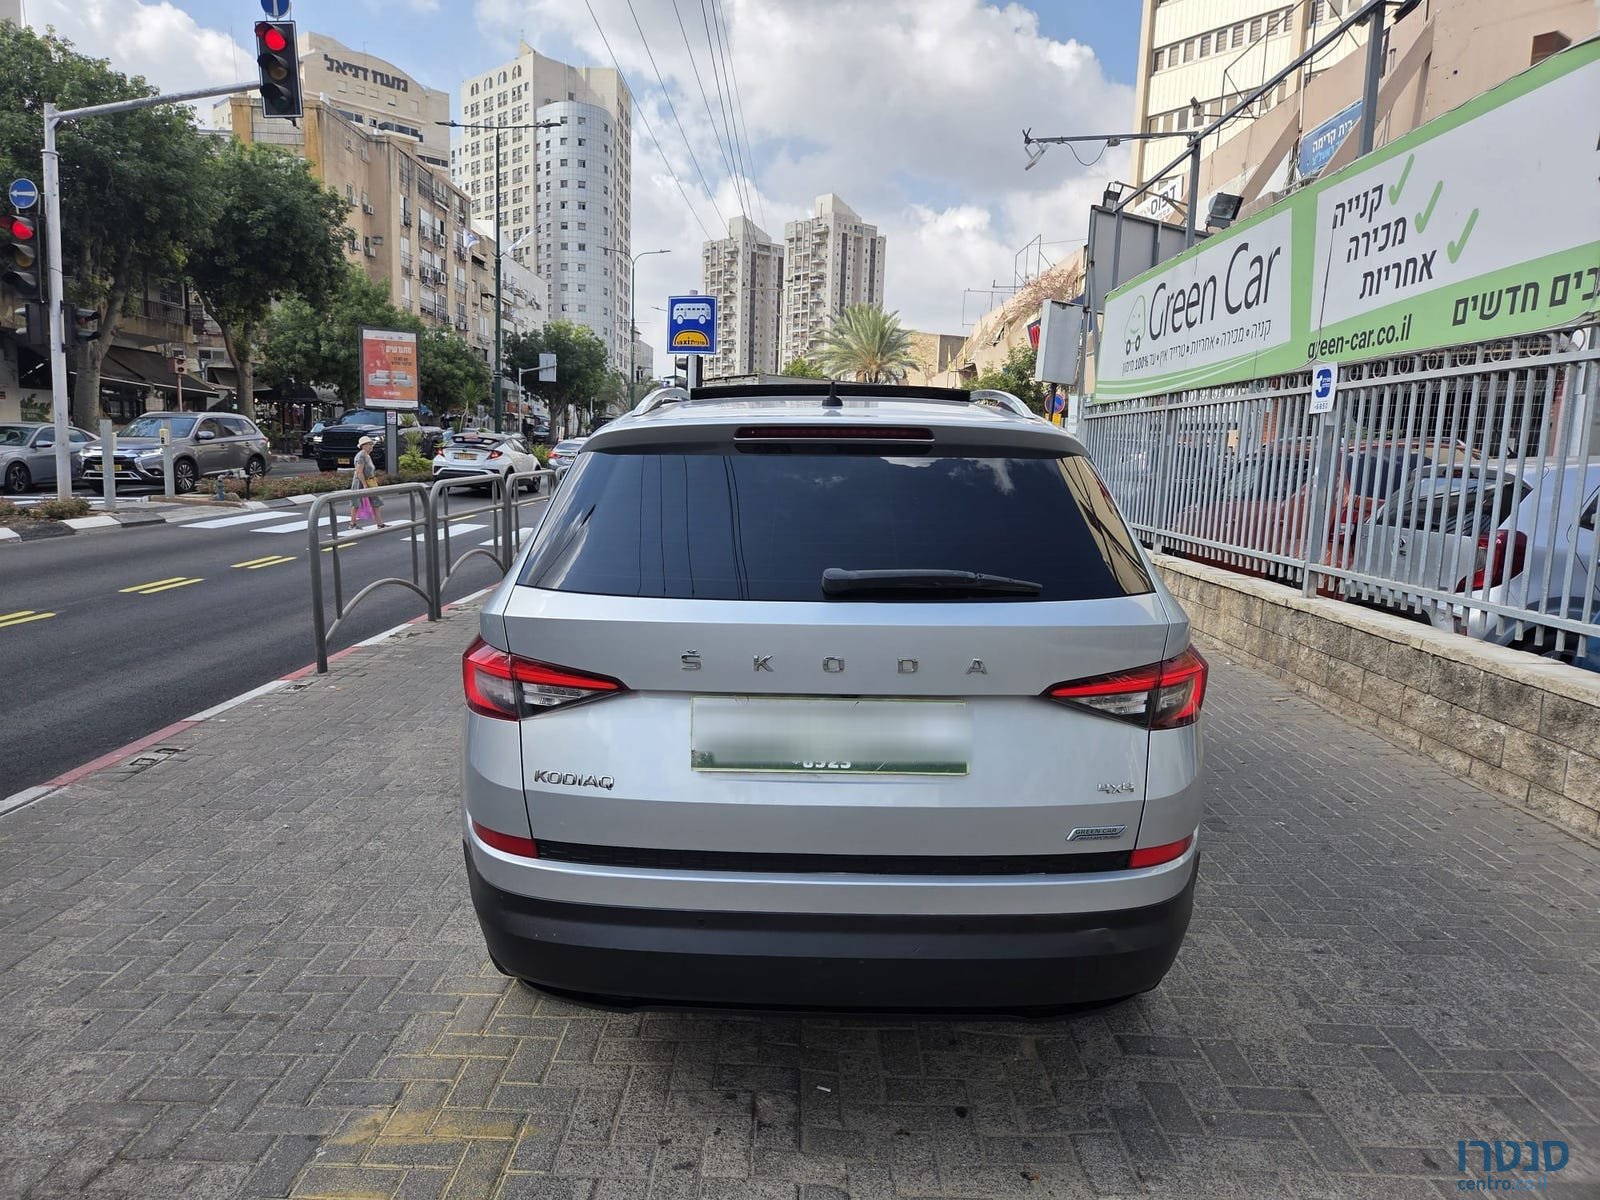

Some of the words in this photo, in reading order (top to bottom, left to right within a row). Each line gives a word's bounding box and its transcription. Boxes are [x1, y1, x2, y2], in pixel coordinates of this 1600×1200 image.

[323, 53, 369, 81] דניאל
[1332, 183, 1384, 230] קנייה
[1346, 216, 1408, 263] מכירה
[1149, 274, 1217, 341] Green
[1224, 242, 1281, 315] Car
[1359, 249, 1438, 300] אחריות
[1451, 281, 1540, 327] חדשים
[1189, 335, 1216, 356] אחריות
[1220, 326, 1244, 347] מכירה
[1250, 319, 1272, 341] קניה
[534, 770, 615, 791] KODIAQ
